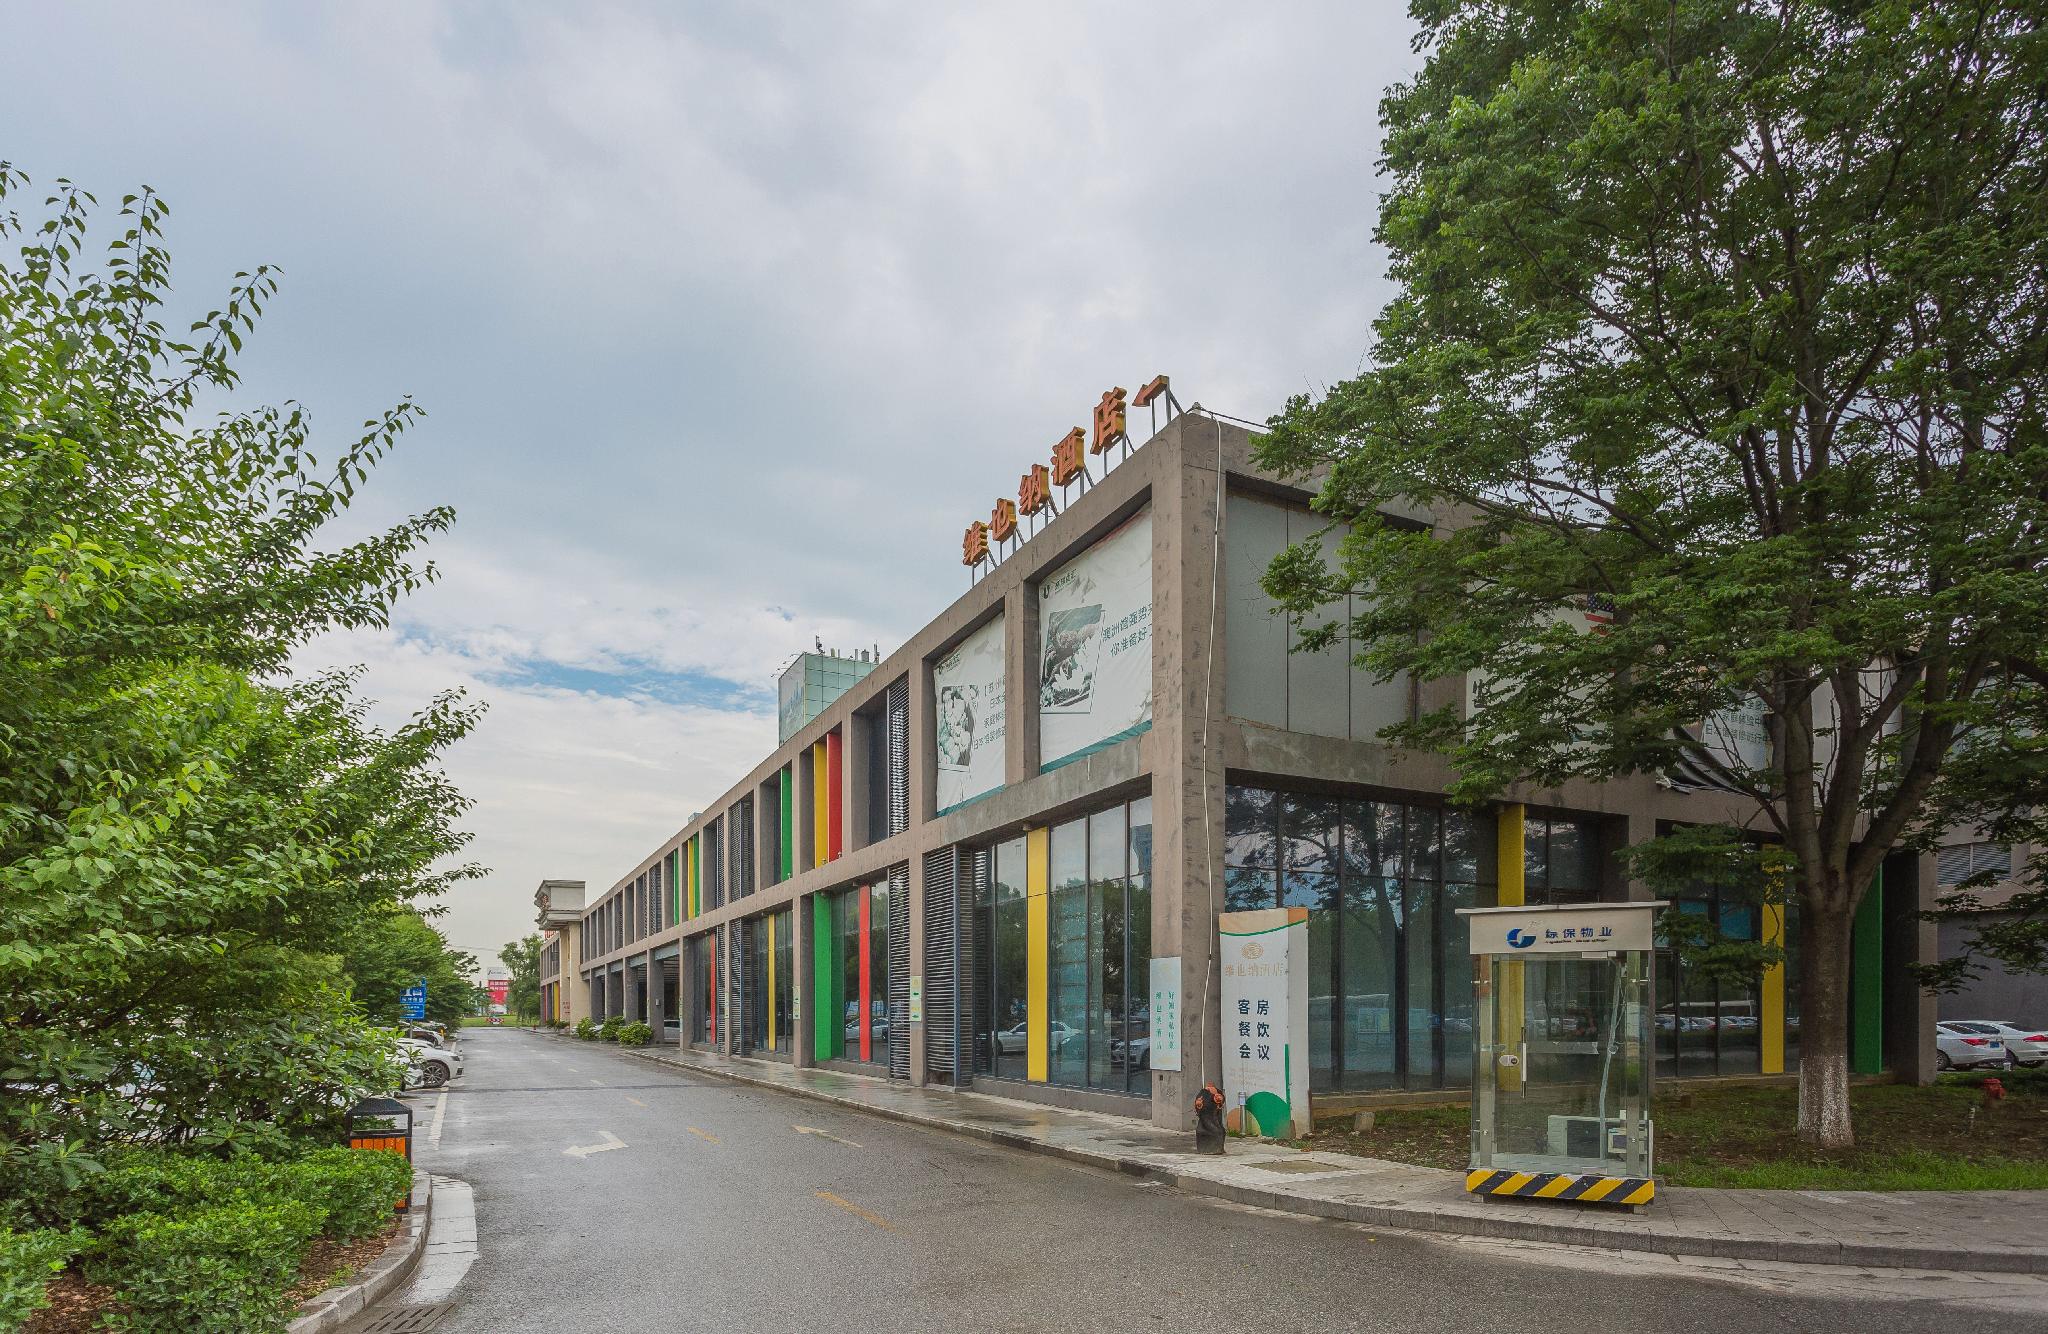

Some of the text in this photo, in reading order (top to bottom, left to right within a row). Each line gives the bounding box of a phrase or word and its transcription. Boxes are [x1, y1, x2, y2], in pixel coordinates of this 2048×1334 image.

[963, 386, 1127, 566] 维也纳酒店
[1238, 999, 1270, 1016] 客房
[1238, 1021, 1270, 1038] 餐饮
[1239, 1043, 1270, 1061] 会议
